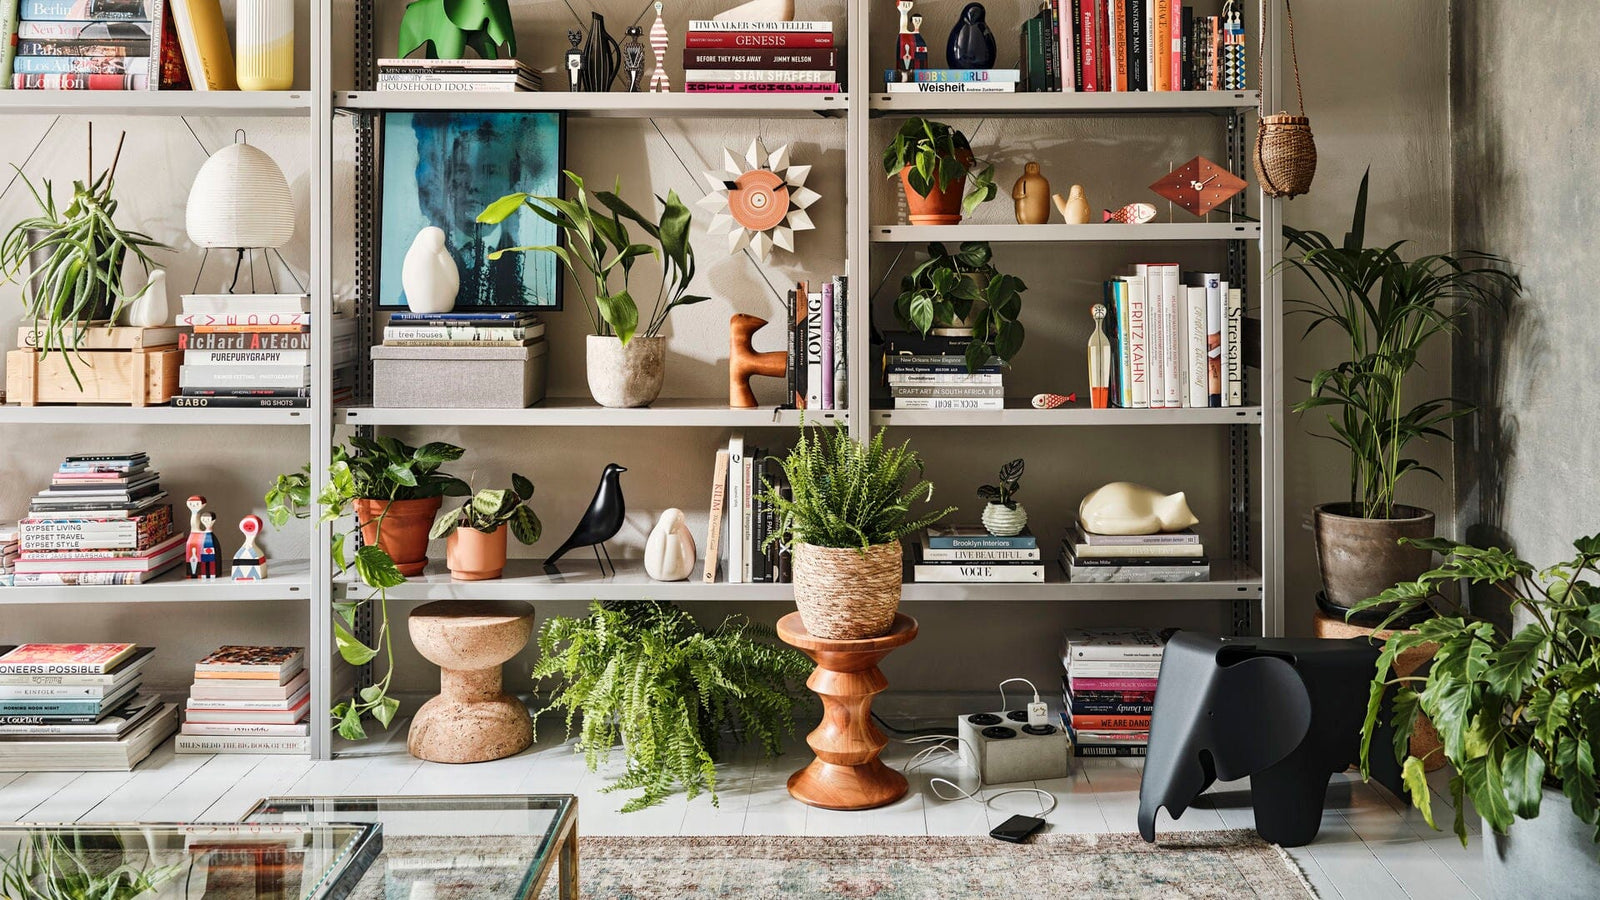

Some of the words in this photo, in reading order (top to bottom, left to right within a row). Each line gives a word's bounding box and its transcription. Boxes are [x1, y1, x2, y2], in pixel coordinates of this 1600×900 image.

[34, 3, 72, 16] Berlin
[1159, 0, 1167, 28] GRACE
[782, 22, 813, 30] TELLER
[1116, 0, 1125, 41] an-Michel
[32, 24, 52, 36] New
[54, 24, 81, 36] York
[736, 36, 786, 46] GENESIS
[33, 44, 62, 56] Paris
[26, 58, 48, 71] Los
[1116, 42, 1126, 76] Basquiat
[26, 74, 84, 89] London
[734, 70, 764, 81] STAN
[767, 70, 821, 81] SHAFFER
[918, 71, 948, 81] BOB'S
[952, 71, 988, 81] WORLD
[380, 83, 442, 91] HOUSEHOLD
[444, 83, 474, 91] IDOLS
[918, 83, 965, 92] Weisheit
[184, 314, 301, 326] AVEDON
[1132, 302, 1143, 339] FRITZ
[398, 328, 414, 338] tree
[416, 327, 443, 338] houses
[808, 299, 821, 366] LOVING
[1228, 307, 1242, 382] Streisand
[211, 353, 280, 362] PUREPURYGRAPHY
[1133, 344, 1144, 383] KAHN
[712, 484, 723, 510] KILIM
[960, 567, 992, 576] VOGUE
[0, 665, 44, 674] ONEERS
[49, 665, 100, 674] POSSIBLE
[1117, 704, 1141, 713] Dandy
